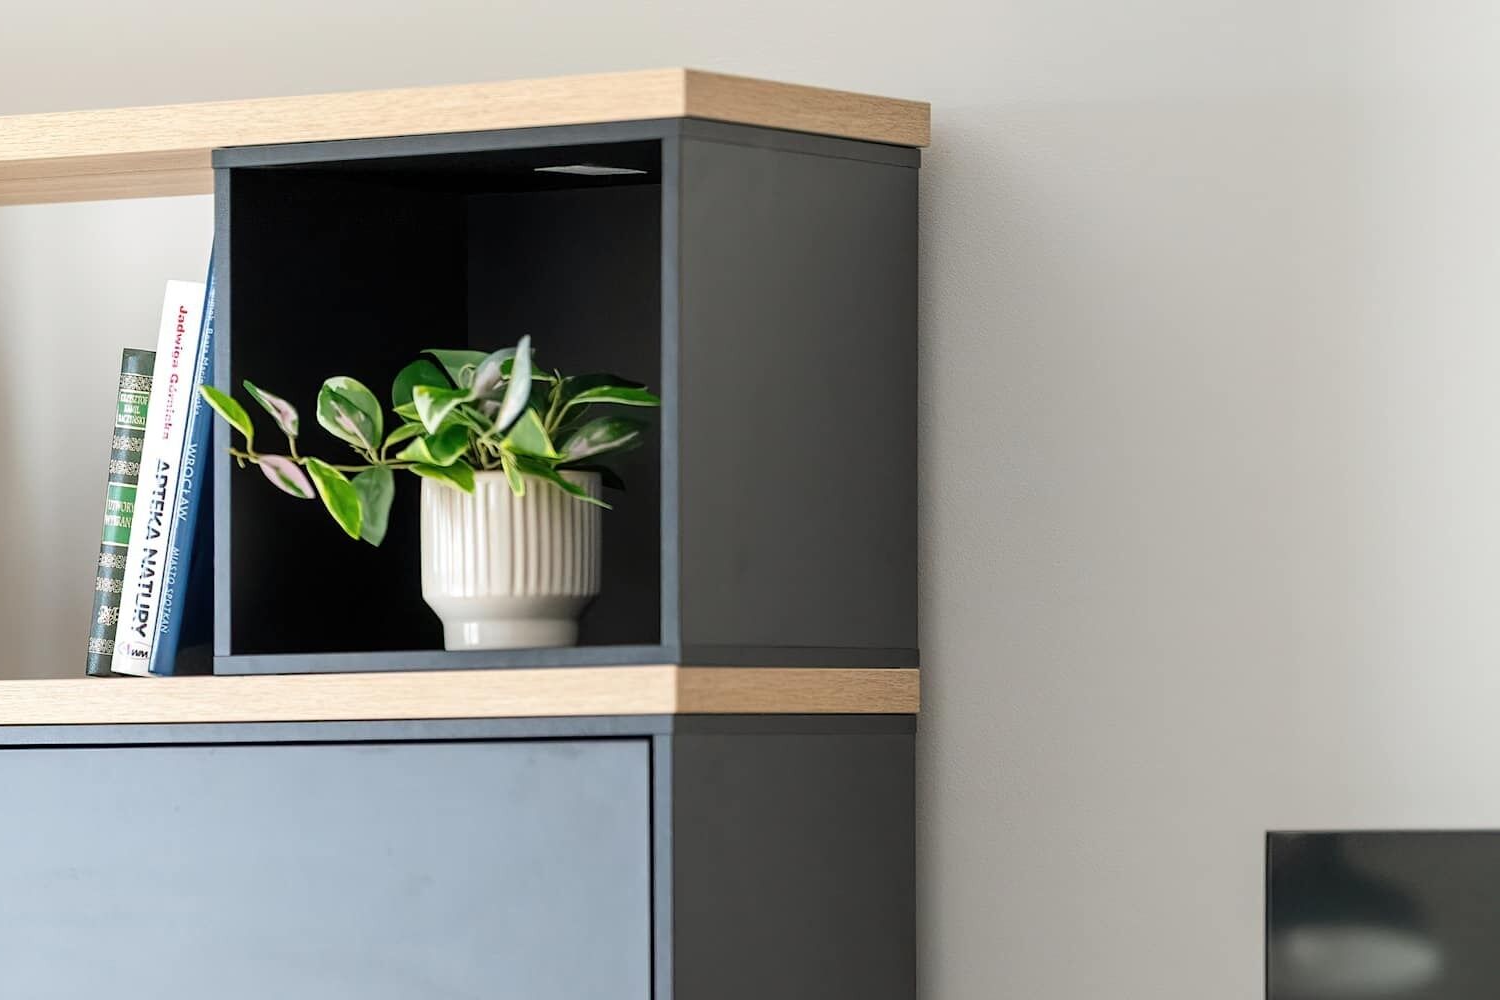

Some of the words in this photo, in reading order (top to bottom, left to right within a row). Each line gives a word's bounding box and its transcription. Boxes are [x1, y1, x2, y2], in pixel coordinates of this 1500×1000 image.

[171, 304, 188, 369] Jadwiga
[146, 457, 171, 541] APTEKA
[176, 442, 198, 522] WROCŁAW
[130, 547, 158, 638] NATURY
[167, 545, 181, 586] MIASTO
